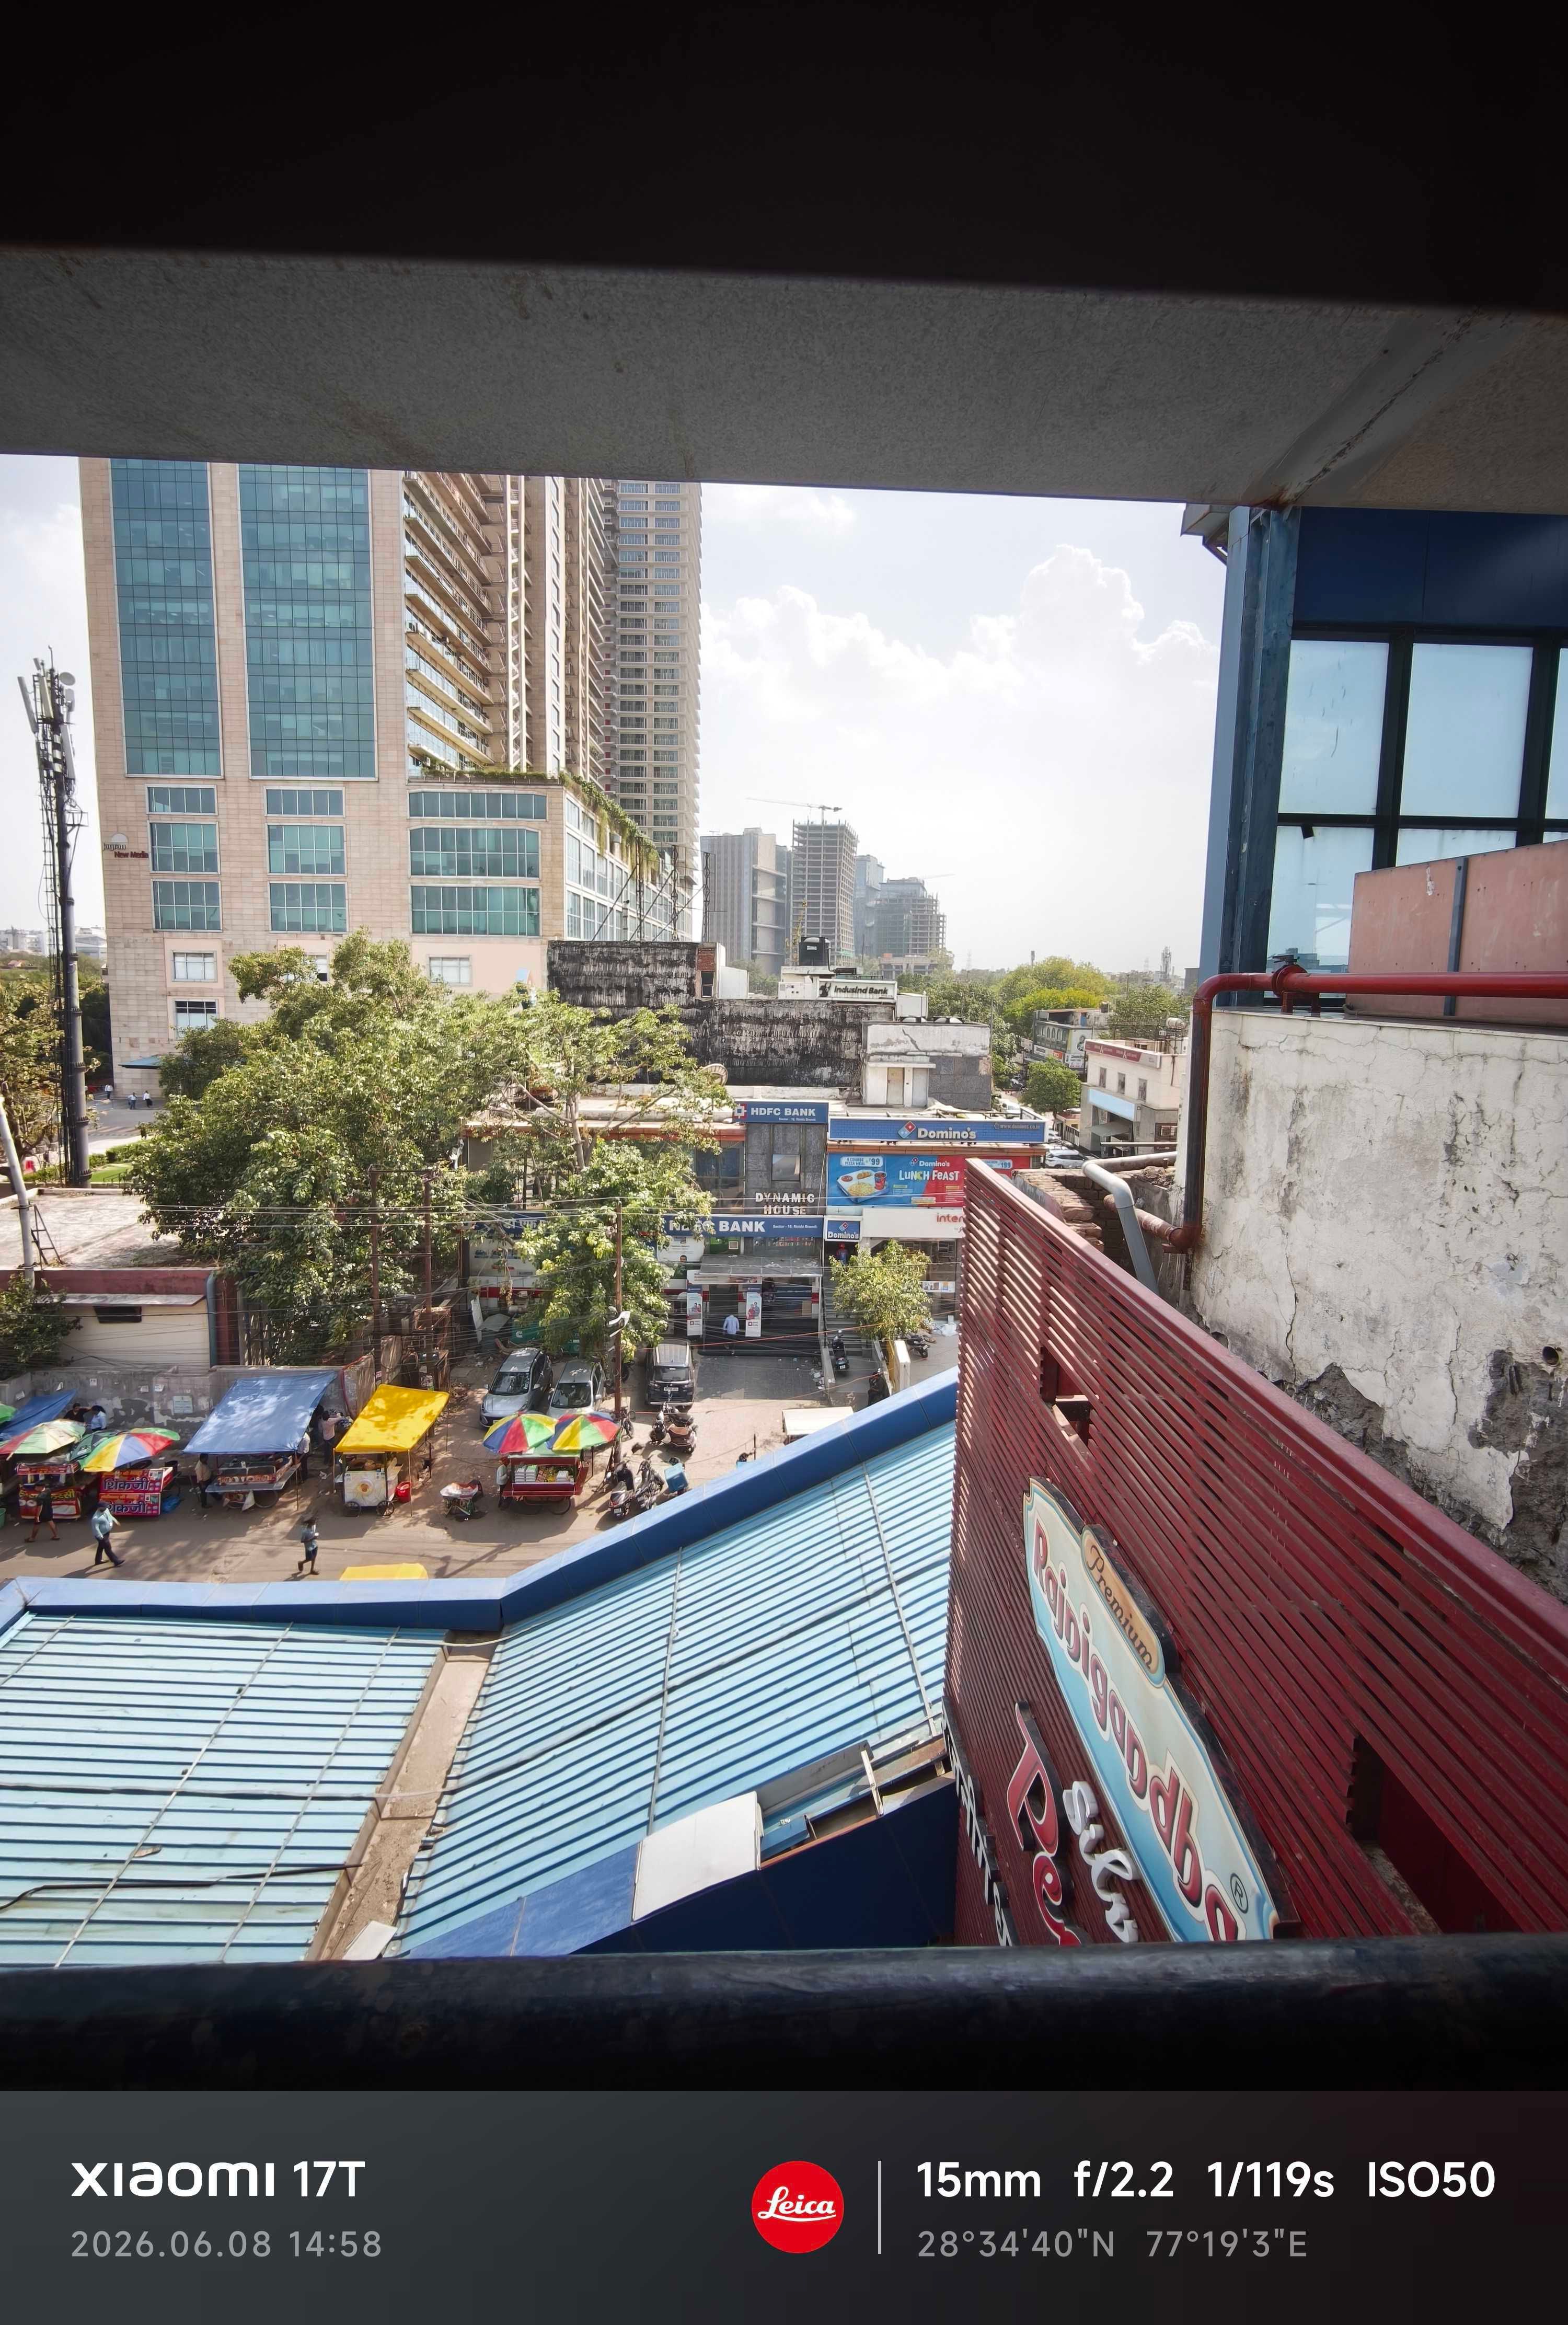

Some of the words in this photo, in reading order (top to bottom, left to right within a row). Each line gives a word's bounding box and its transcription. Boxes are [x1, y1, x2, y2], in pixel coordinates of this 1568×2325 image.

[834, 985, 868, 994] IndusInd
[751, 1107, 781, 1115] HDFC
[784, 1108, 816, 1117] BANK
[917, 1127, 976, 1140] Domino's
[755, 1192, 815, 1203] DYNAMIC
[764, 1205, 808, 1215] HOUSE
[719, 1221, 766, 1233] BANK
[827, 1231, 859, 1239] Domino's
[1087, 1545, 1152, 1669] Premium
